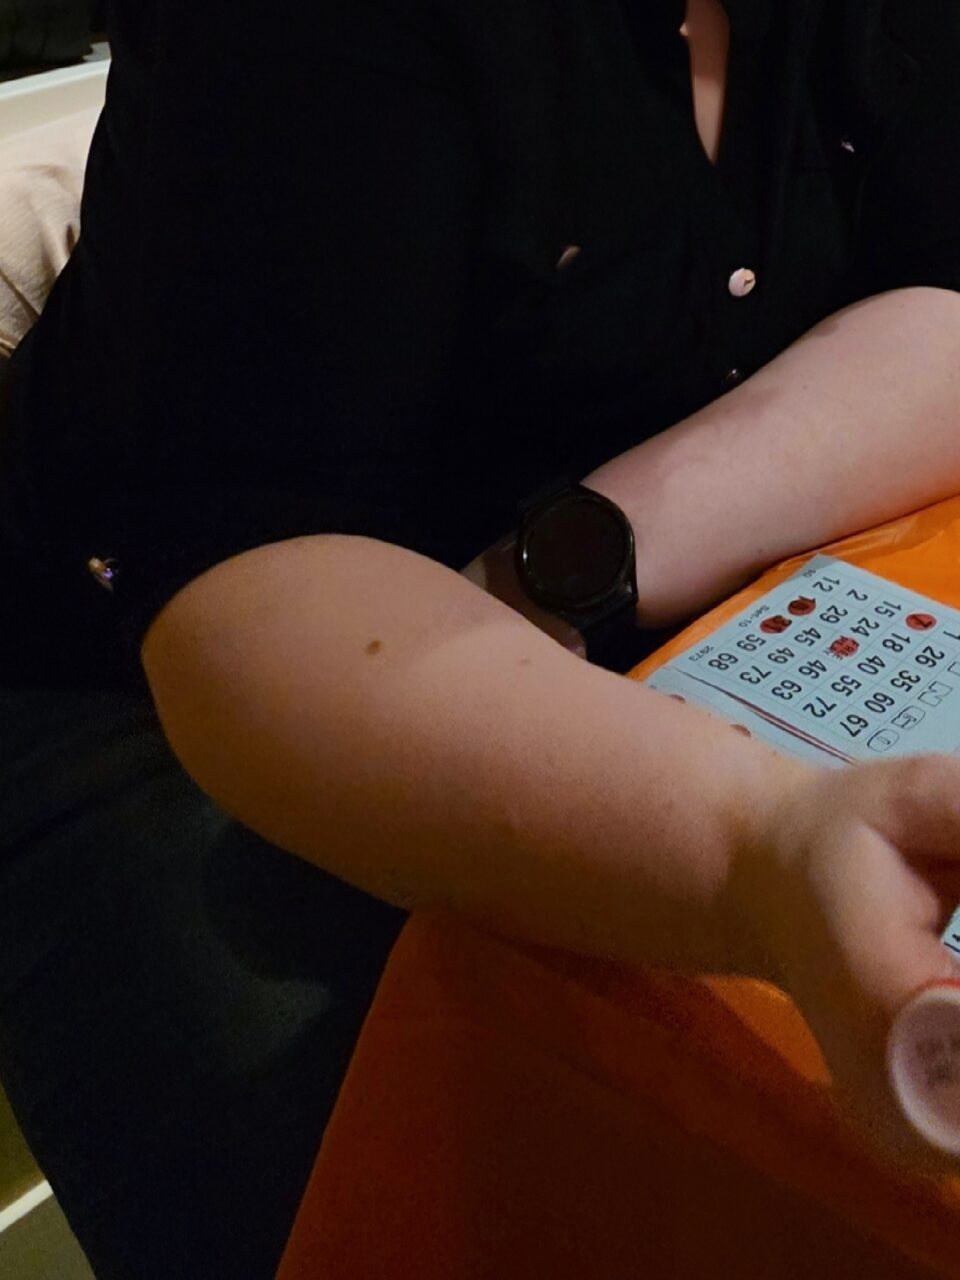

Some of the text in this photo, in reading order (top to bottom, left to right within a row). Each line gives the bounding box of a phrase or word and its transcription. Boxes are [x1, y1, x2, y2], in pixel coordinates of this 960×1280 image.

[846, 588, 869, 601] 2
[707, 576, 840, 671] 12 59 68
[819, 604, 849, 624] 29
[793, 627, 822, 647] 45
[767, 647, 796, 664] 49
[771, 600, 902, 701] 15 24 46 63
[914, 645, 946, 668] 26
[739, 665, 772, 685] 73
[802, 632, 911, 719] 18 40 55 72
[889, 669, 922, 693] 35
[863, 692, 896, 714] 60
[839, 714, 869, 738] 67
